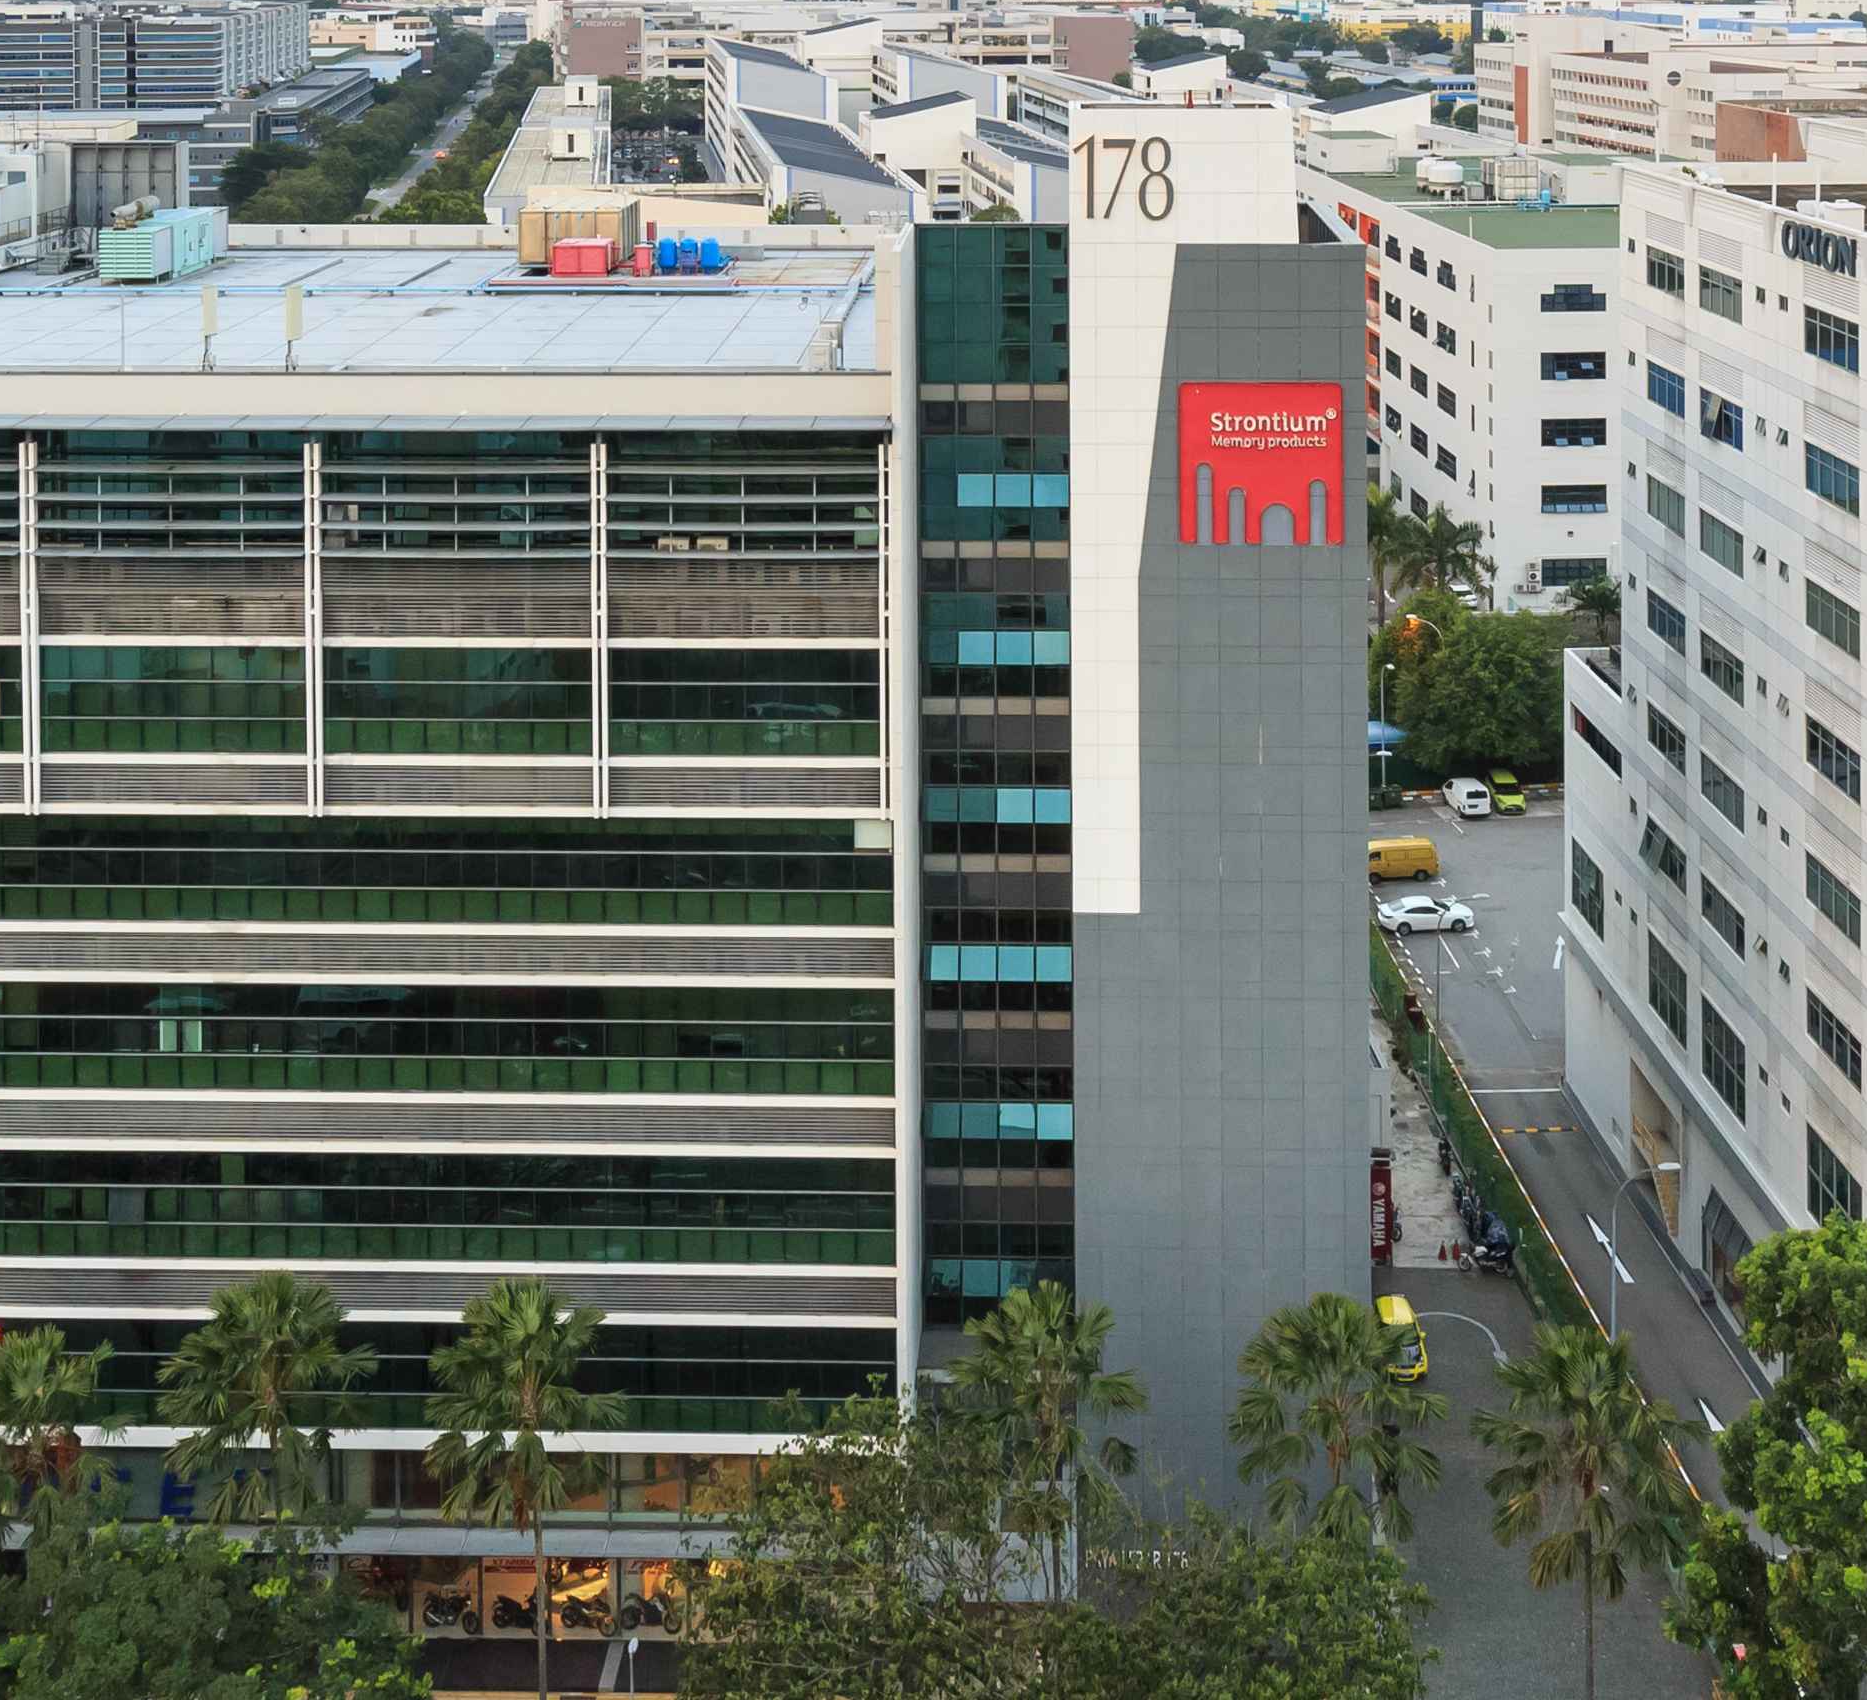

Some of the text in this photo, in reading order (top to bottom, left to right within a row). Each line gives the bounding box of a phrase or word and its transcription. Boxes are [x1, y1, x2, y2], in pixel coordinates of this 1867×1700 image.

[1073, 134, 1174, 221] 178
[1781, 220, 1857, 278] ORION
[1211, 434, 1327, 450] Memory products
[1372, 1199, 1386, 1247] YAMAHA
